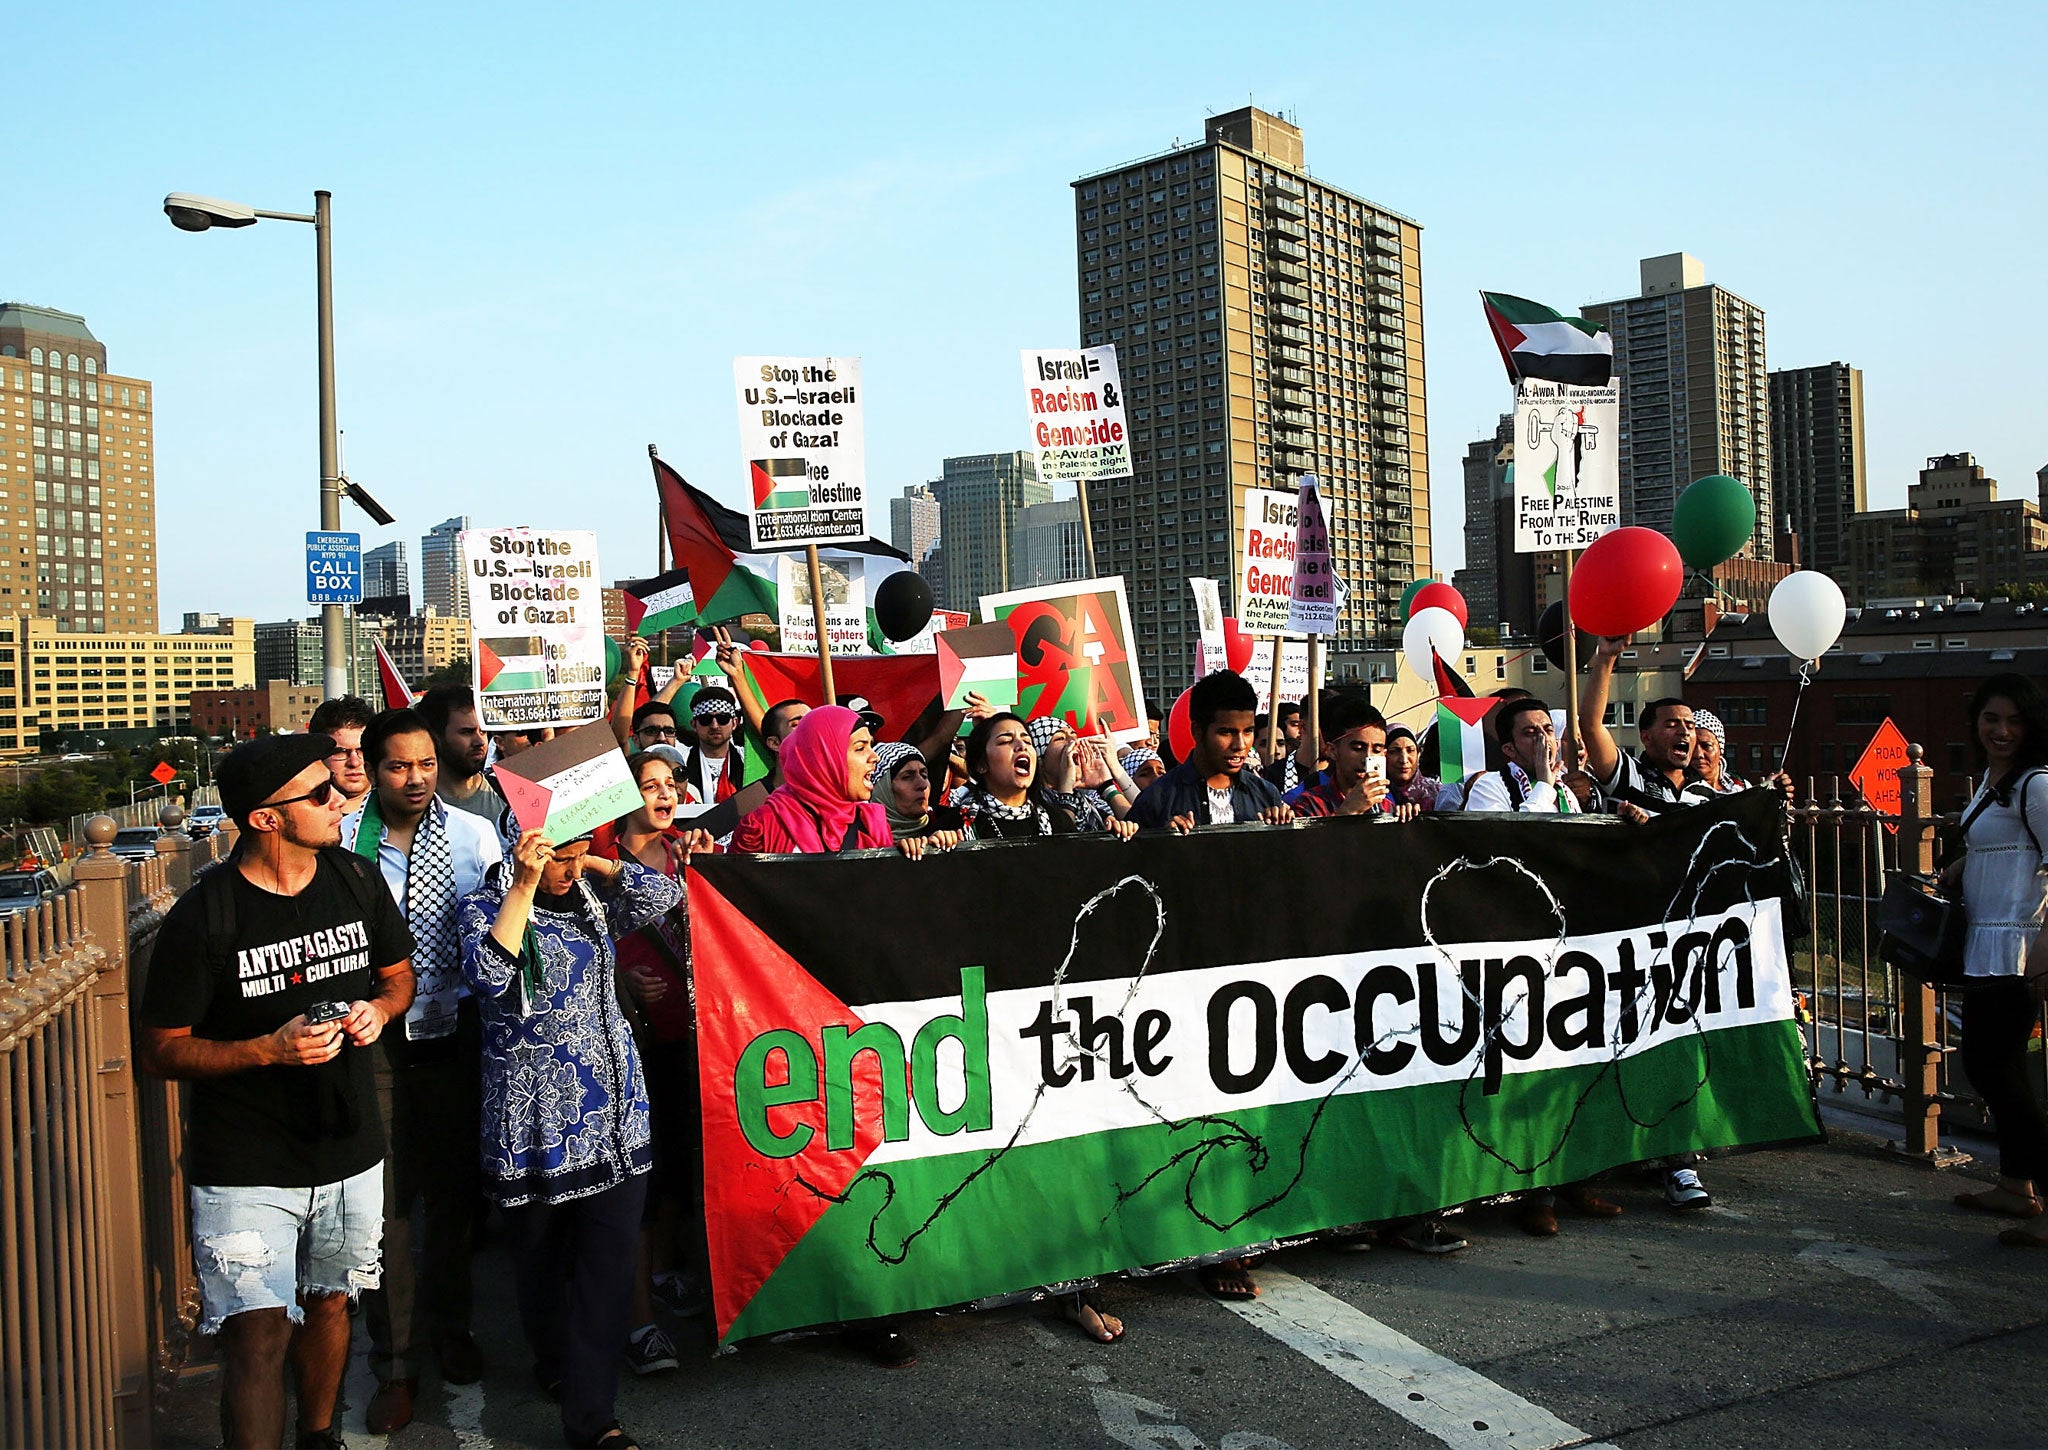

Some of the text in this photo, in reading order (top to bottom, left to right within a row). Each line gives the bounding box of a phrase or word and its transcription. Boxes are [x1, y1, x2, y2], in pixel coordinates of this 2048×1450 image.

[761, 365, 836, 385] Stop the
[1037, 354, 1100, 381] Israel=
[1031, 382, 1120, 413] Racism &
[762, 410, 843, 427] Blockade
[770, 431, 839, 448] of Gaza!
[1036, 418, 1123, 448] Genocide
[1102, 444, 1124, 457] NY
[1100, 456, 1126, 466] Right
[832, 509, 862, 521] Center
[306, 543, 360, 552] PUBLIC ASSISTANCE
[490, 536, 572, 557] Stop the
[309, 560, 359, 575] CALL
[315, 575, 352, 590] BOX
[490, 583, 580, 601] Blockade
[498, 606, 576, 624] of Gaza!
[844, 617, 860, 626] are
[1246, 610, 1261, 618] the
[1245, 620, 1255, 629] to
[784, 627, 864, 642] Freedo Fighters
[842, 643, 861, 653] NY
[481, 693, 545, 709] International
[571, 690, 603, 703] Center
[486, 705, 551, 722] 212.633.6646
[1876, 747, 1902, 760] ROAD
[1878, 768, 1899, 781] WOR
[1875, 789, 1900, 803] AHEA
[238, 920, 369, 979] ANTOFAGASTA
[241, 950, 369, 998] MULTI CULTURAL
[734, 915, 1756, 1160] end the occupation
